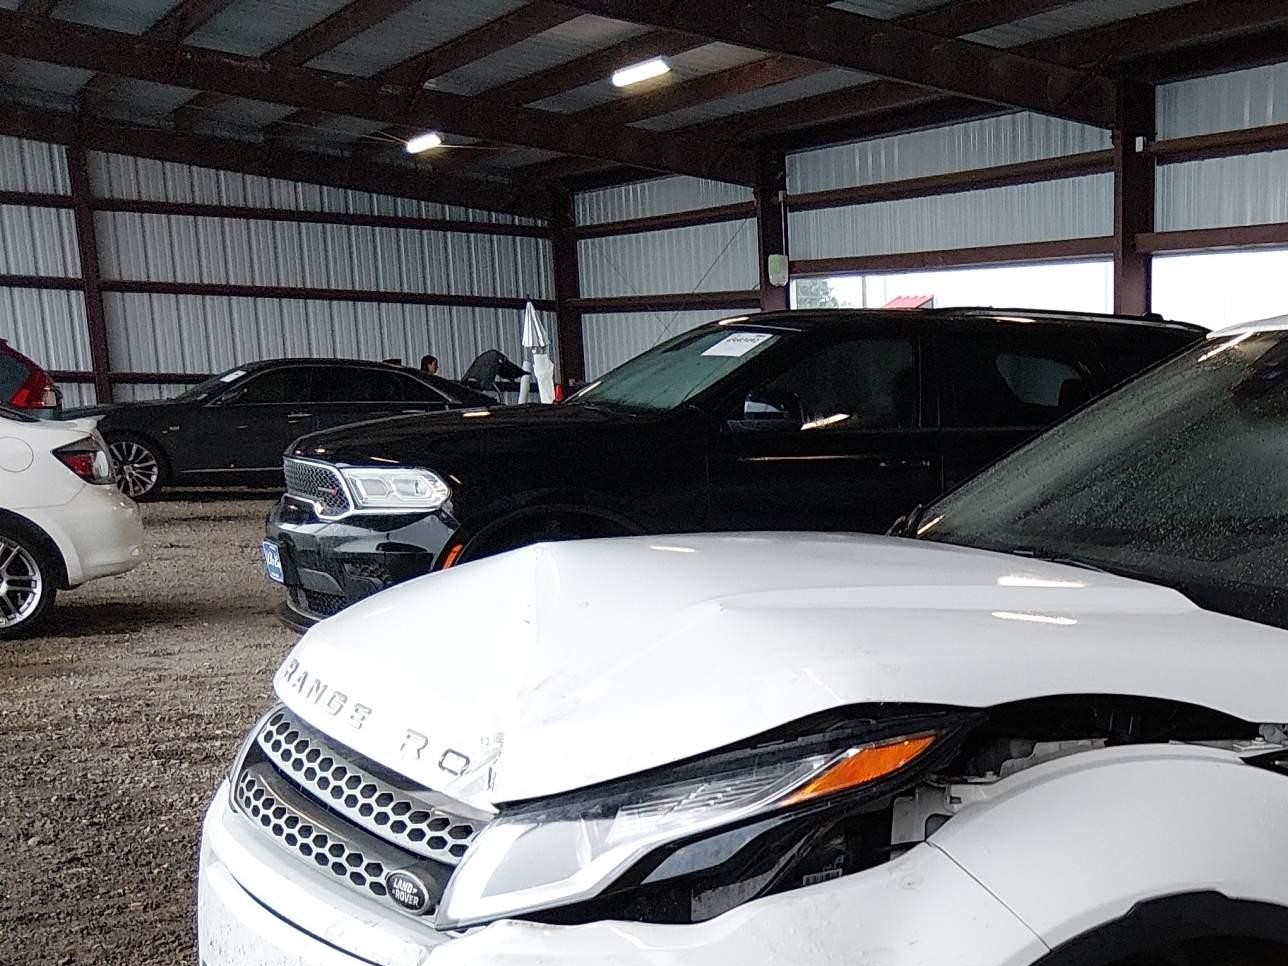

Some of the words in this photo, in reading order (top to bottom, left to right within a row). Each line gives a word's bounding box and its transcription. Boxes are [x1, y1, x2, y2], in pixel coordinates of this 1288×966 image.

[284, 658, 373, 730] RANGE
[393, 877, 414, 894] LAND
[395, 889, 420, 908] ROVER
